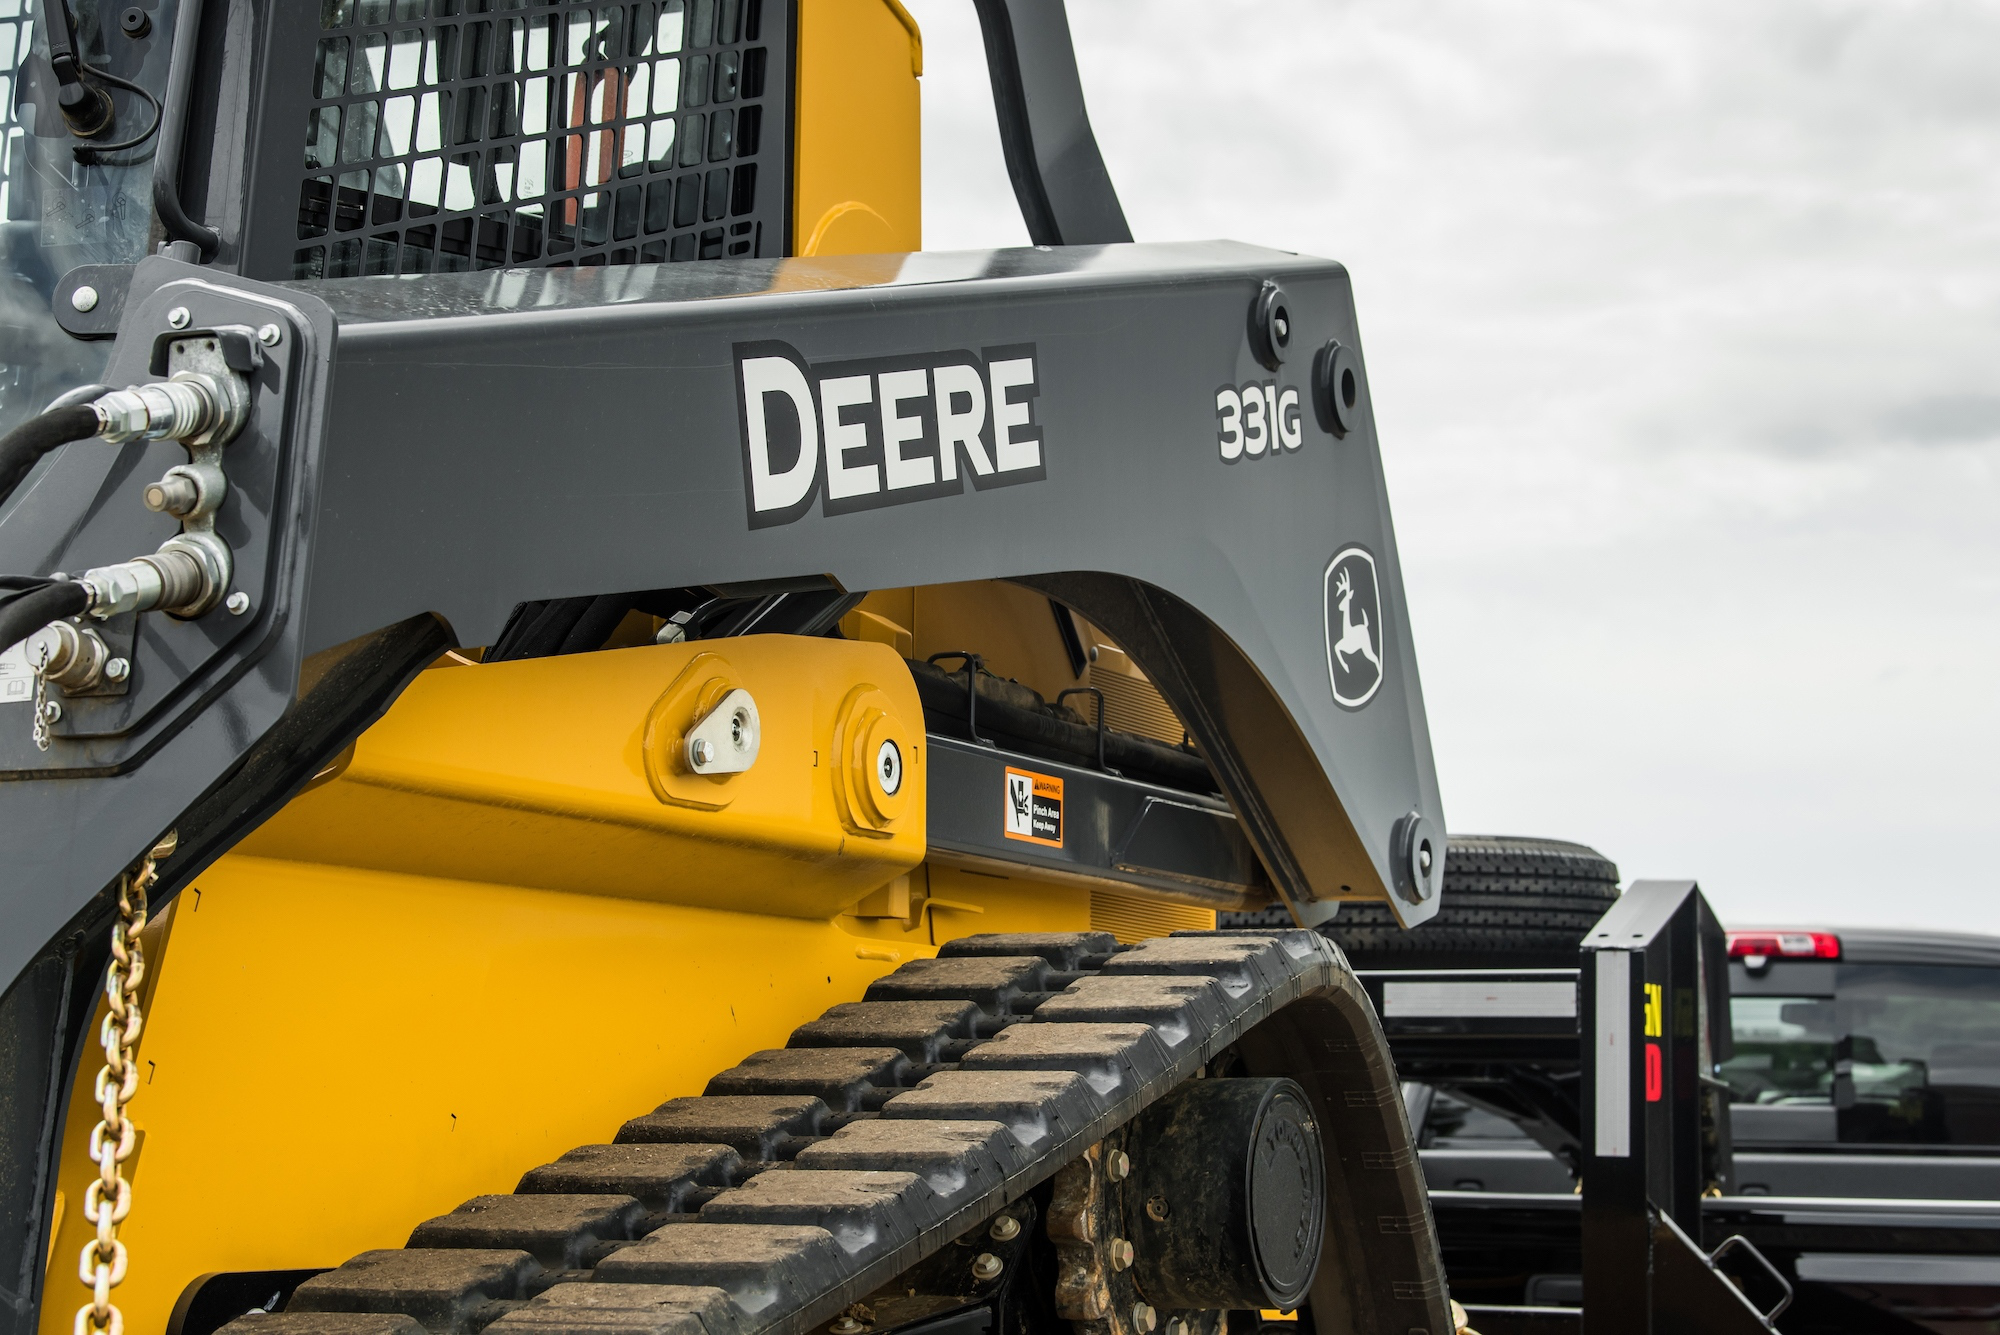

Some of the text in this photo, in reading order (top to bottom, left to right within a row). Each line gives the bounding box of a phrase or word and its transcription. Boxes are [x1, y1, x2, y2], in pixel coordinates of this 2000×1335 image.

[1217, 385, 1302, 459] 331G
[741, 356, 1040, 512] DEERE
[1039, 781, 1060, 794] WARNING
[1033, 804, 1059, 819] Pinch Area
[1033, 819, 1056, 834] Keep Away
